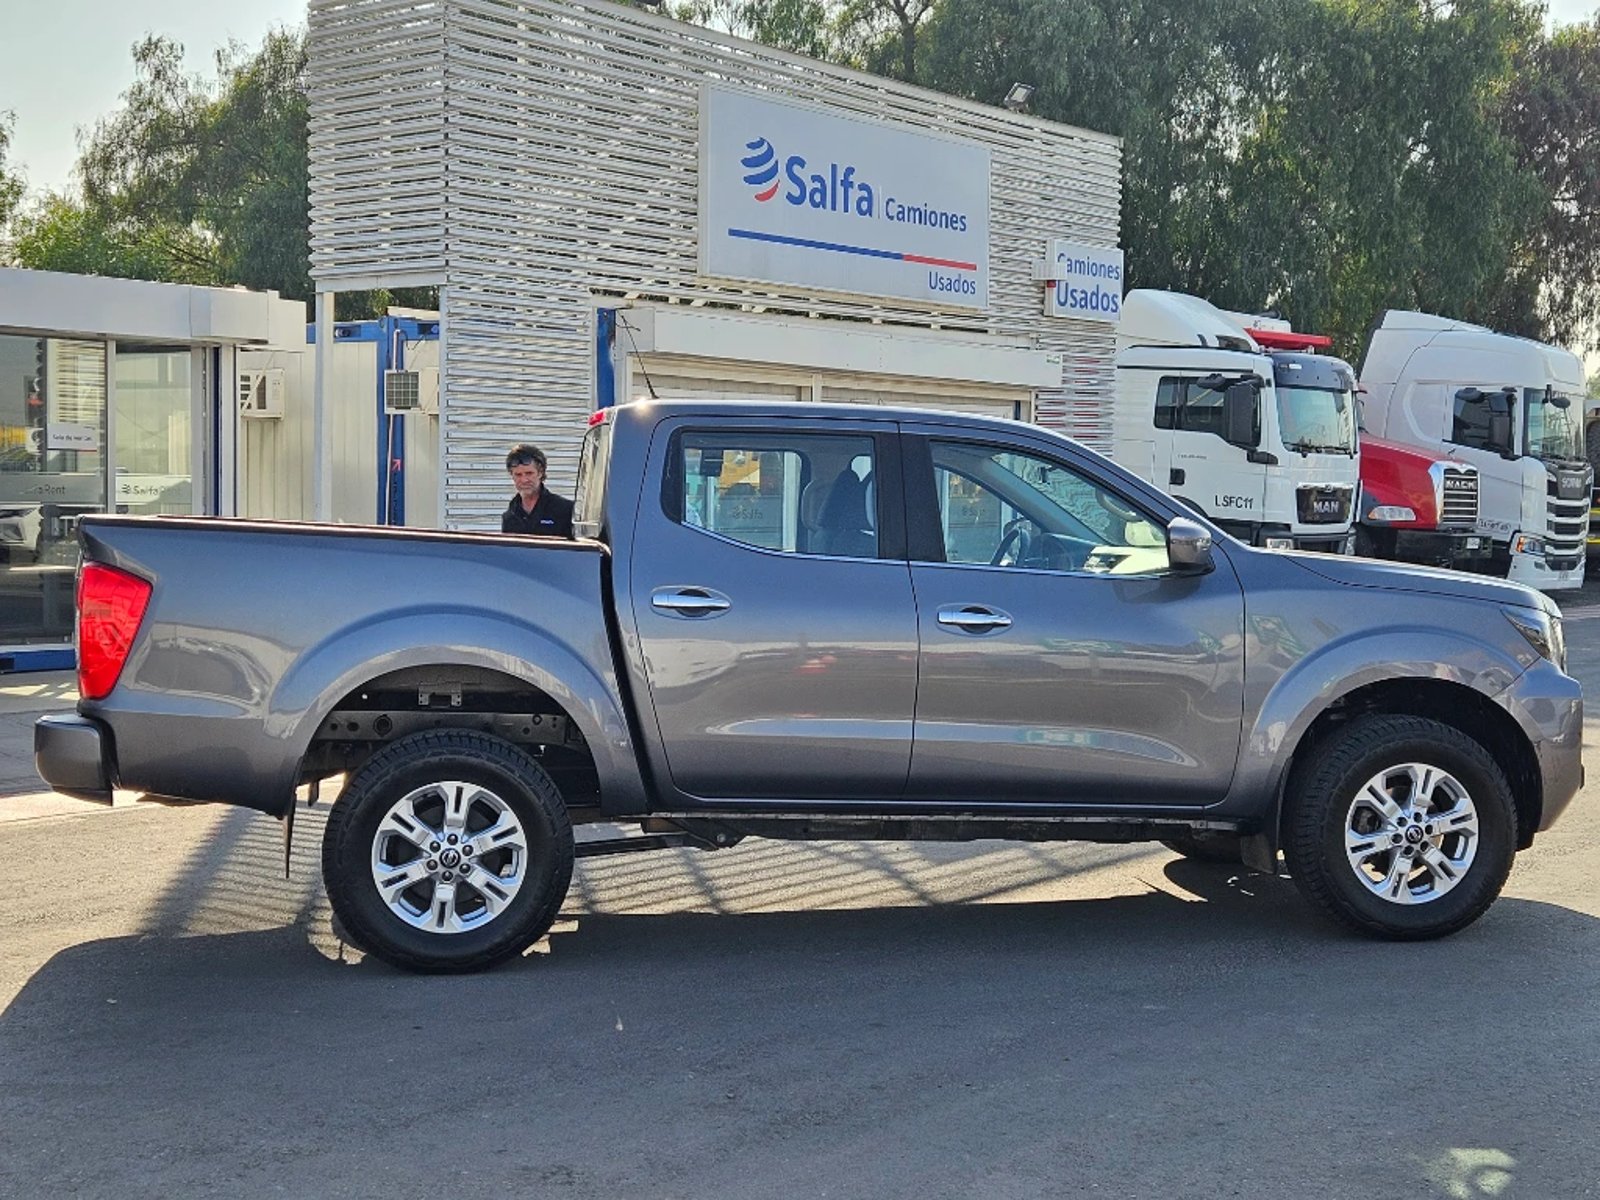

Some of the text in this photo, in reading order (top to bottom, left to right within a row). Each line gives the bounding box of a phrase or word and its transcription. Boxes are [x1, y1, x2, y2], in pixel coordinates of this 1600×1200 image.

[785, 155, 967, 232] Salfa Camiones
[928, 271, 976, 295] Usados
[1056, 280, 1119, 313] Usados
[1214, 495, 1254, 510] LSFC11
[1313, 501, 1340, 513] MAN
